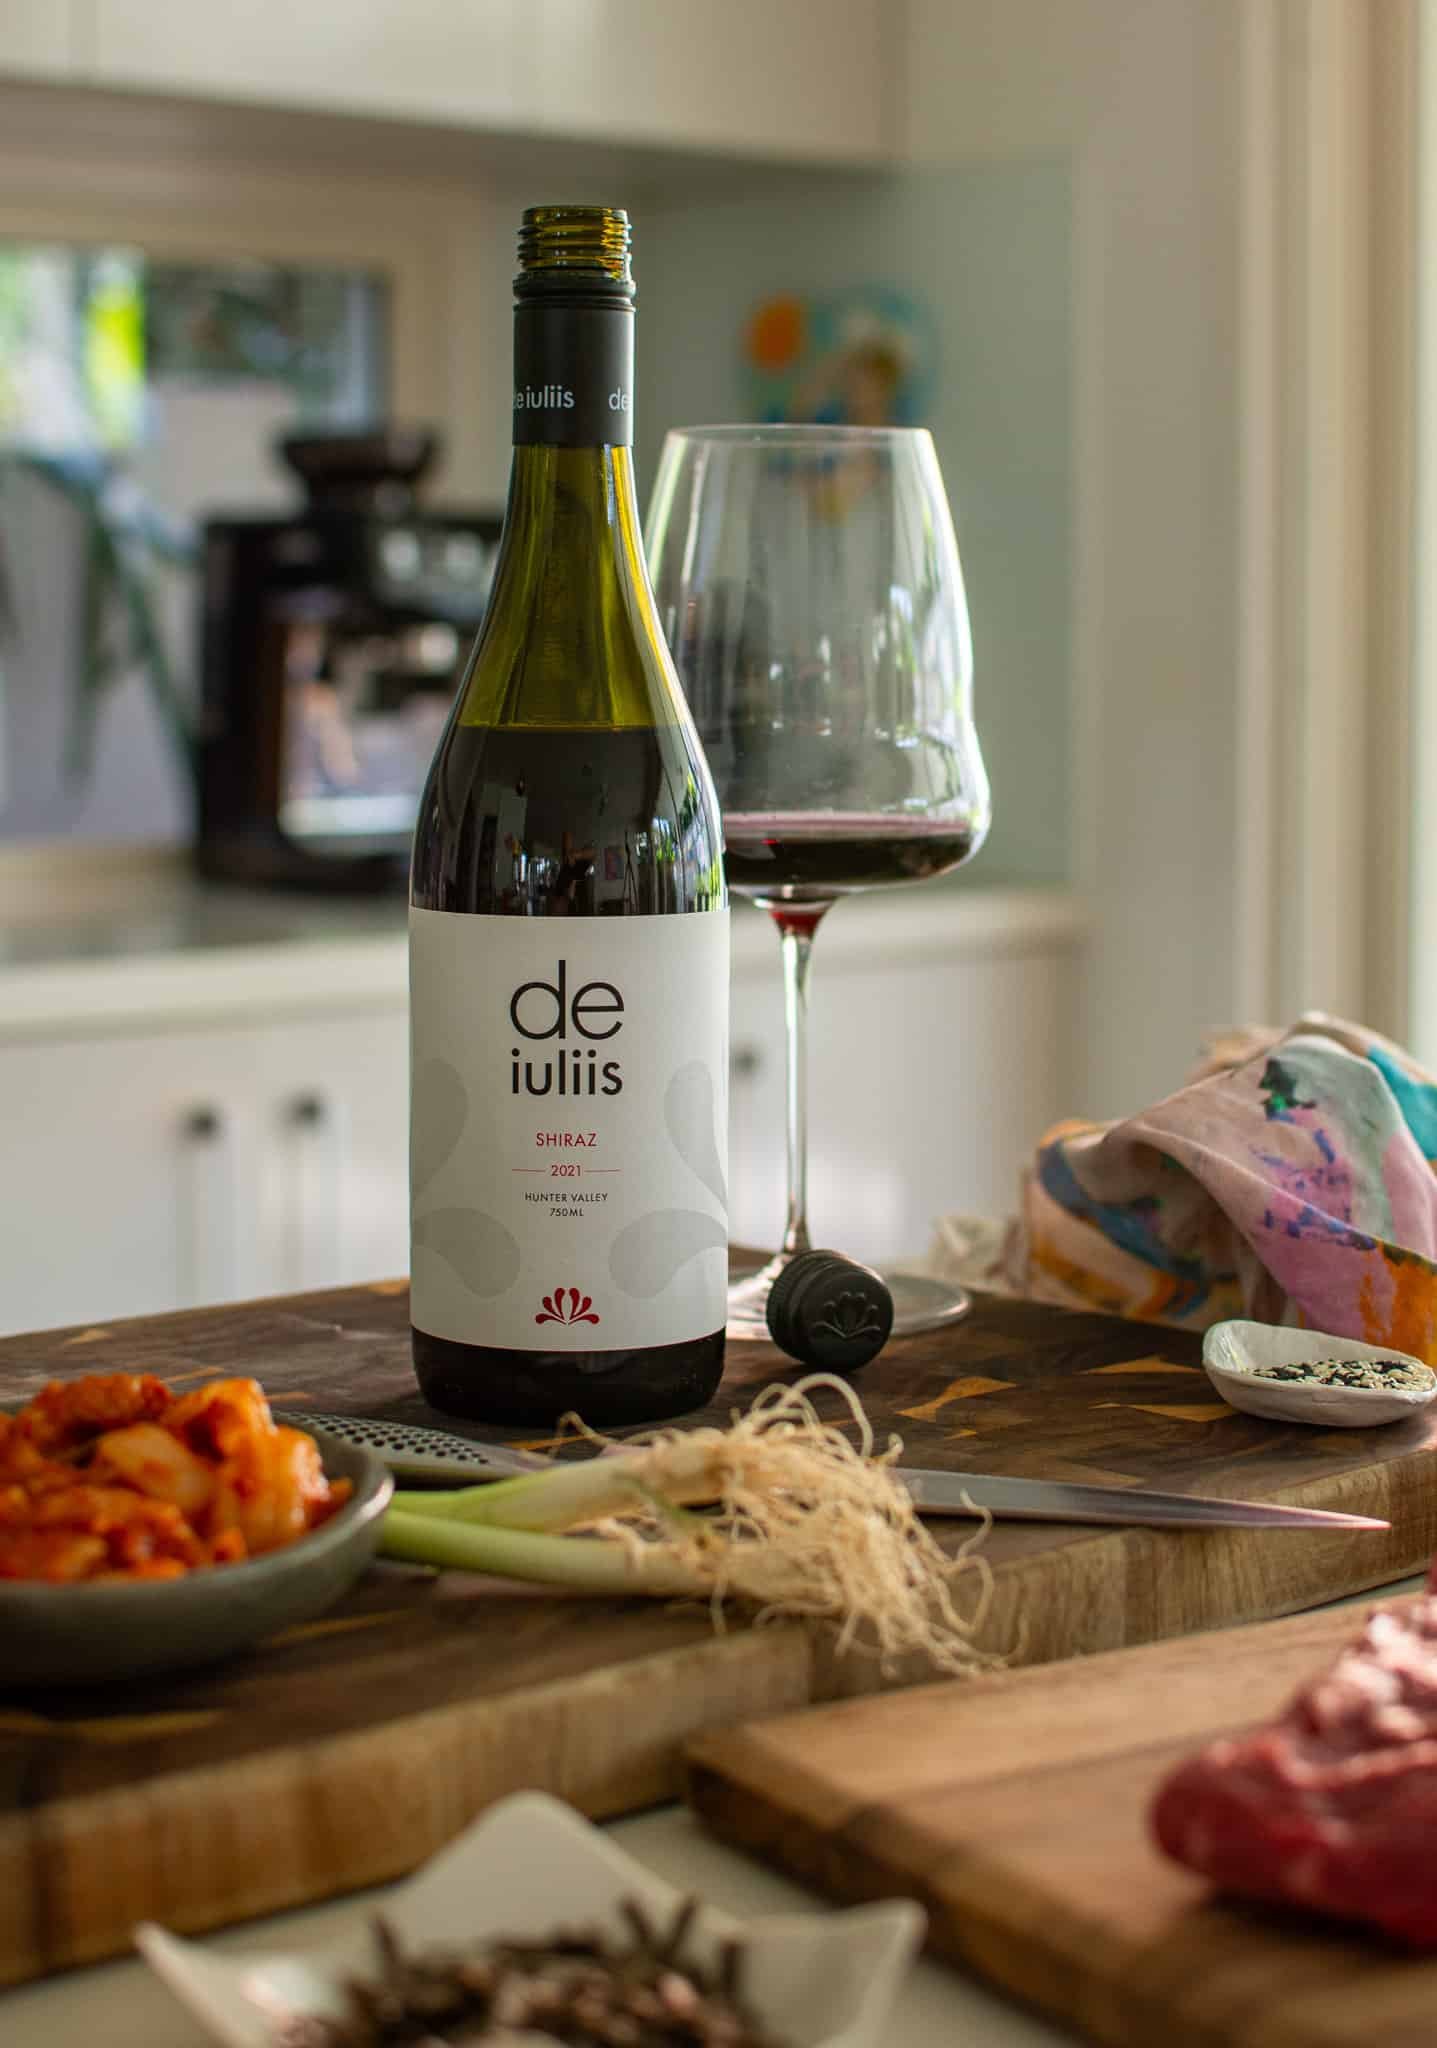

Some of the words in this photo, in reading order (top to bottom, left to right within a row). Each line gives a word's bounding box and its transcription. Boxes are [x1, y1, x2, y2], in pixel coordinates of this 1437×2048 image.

[510, 959, 624, 1040] de
[511, 1048, 622, 1096] iuliis
[536, 1132, 597, 1147] SHIRAZ
[551, 1165, 581, 1177] 2021
[525, 1192, 567, 1202] HUNTER
[570, 1192, 608, 1202] VALLEY
[549, 1207, 584, 1217] 750ML
